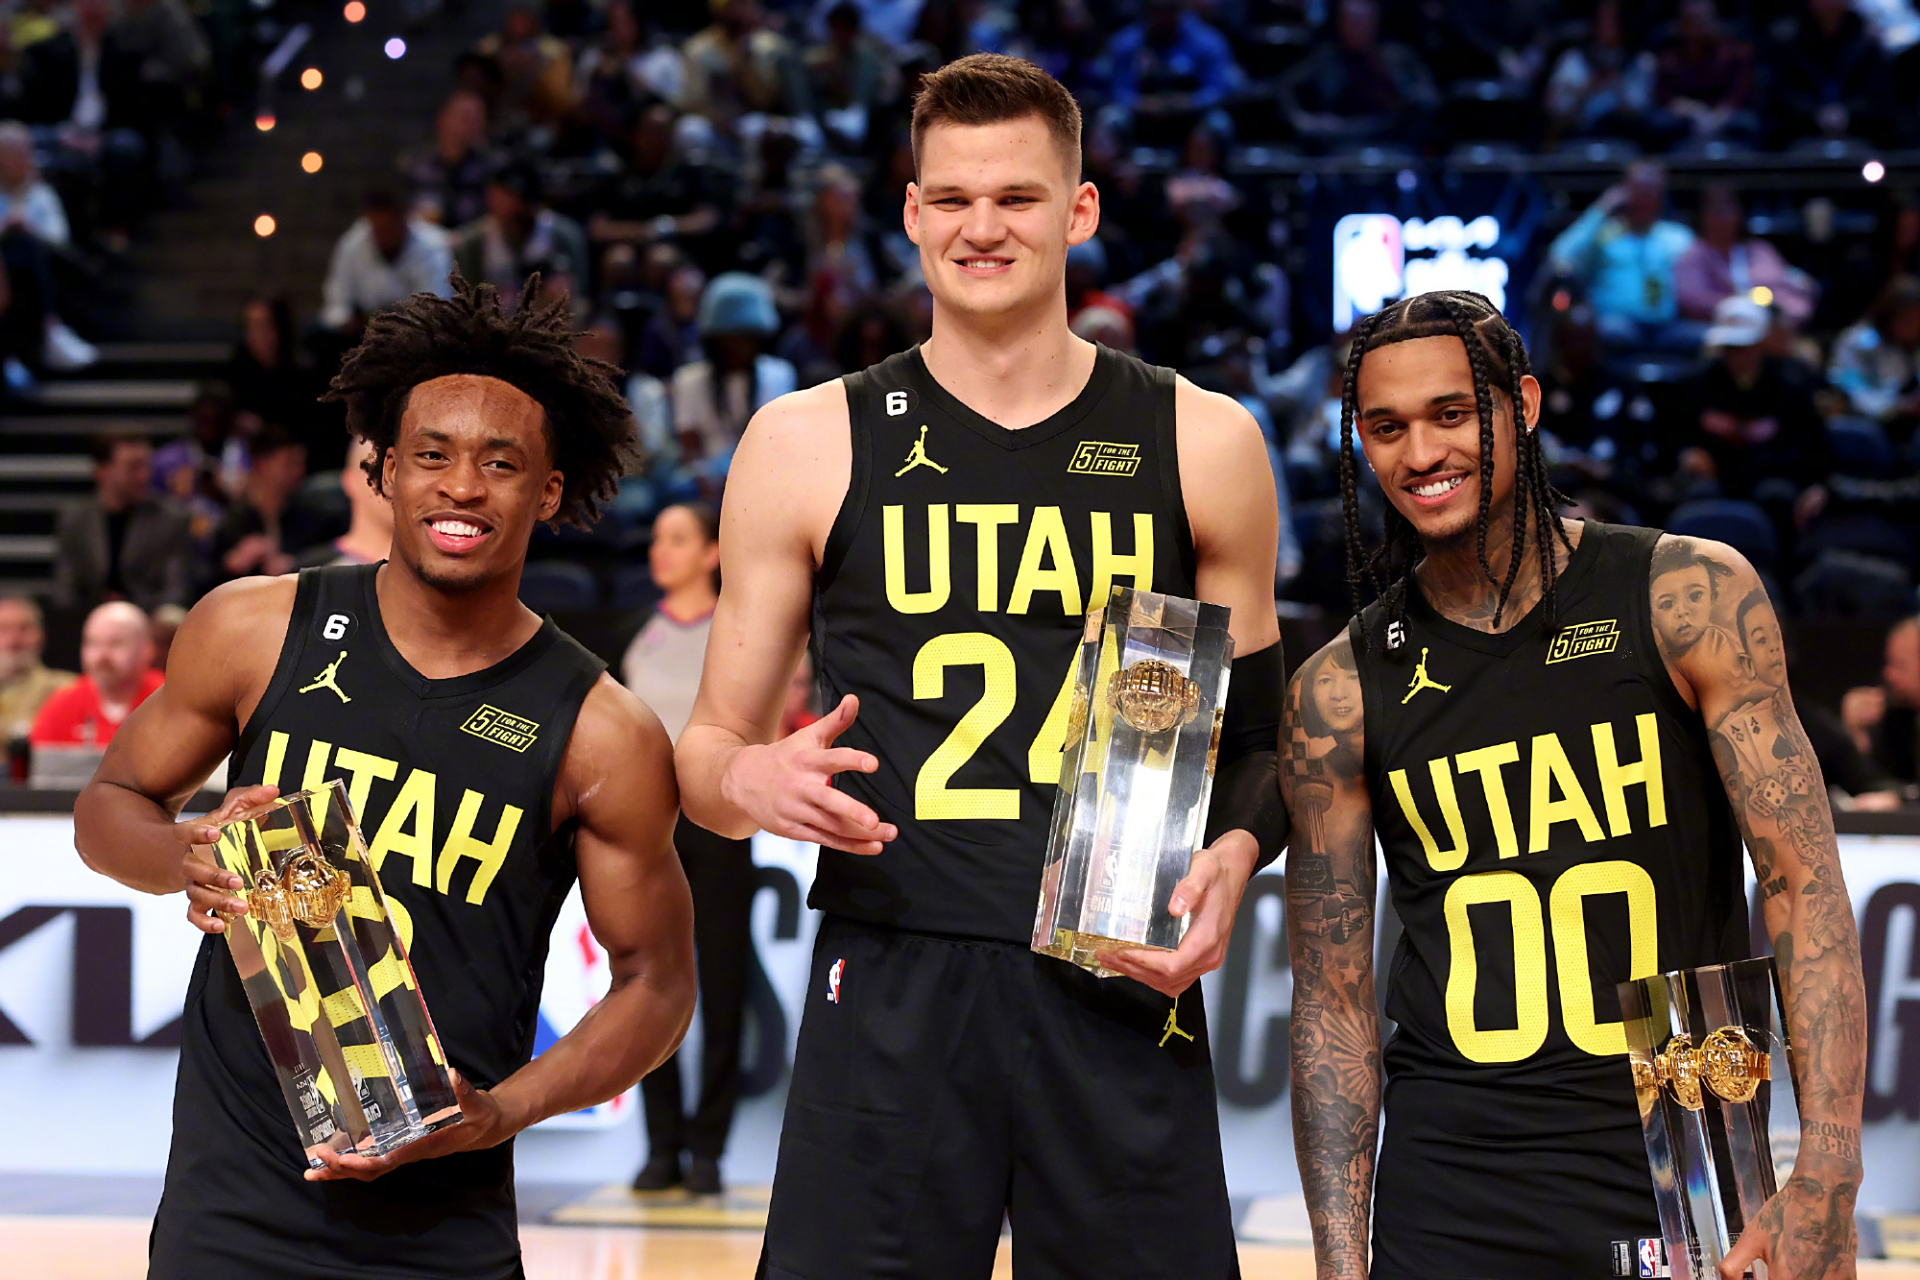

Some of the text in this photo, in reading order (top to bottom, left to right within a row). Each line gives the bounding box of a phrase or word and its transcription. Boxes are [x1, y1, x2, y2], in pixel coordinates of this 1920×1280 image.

[885, 391, 908, 416] 6
[1076, 446, 1096, 470] 5
[1102, 446, 1132, 456] FOR THE
[1094, 459, 1134, 472] FIGHT
[883, 503, 1155, 616] UTAH
[322, 614, 350, 639] 6
[1578, 624, 1610, 636] FOR THE
[1553, 631, 1572, 659] 5
[1573, 636, 1613, 654] FIGHT
[469, 709, 497, 732] 5
[500, 716, 531, 732] FOR THE
[488, 726, 529, 747] FIGHT
[1388, 712, 1668, 872] UTAH
[261, 730, 524, 906] UTAH
[1443, 860, 1668, 1063] 00
